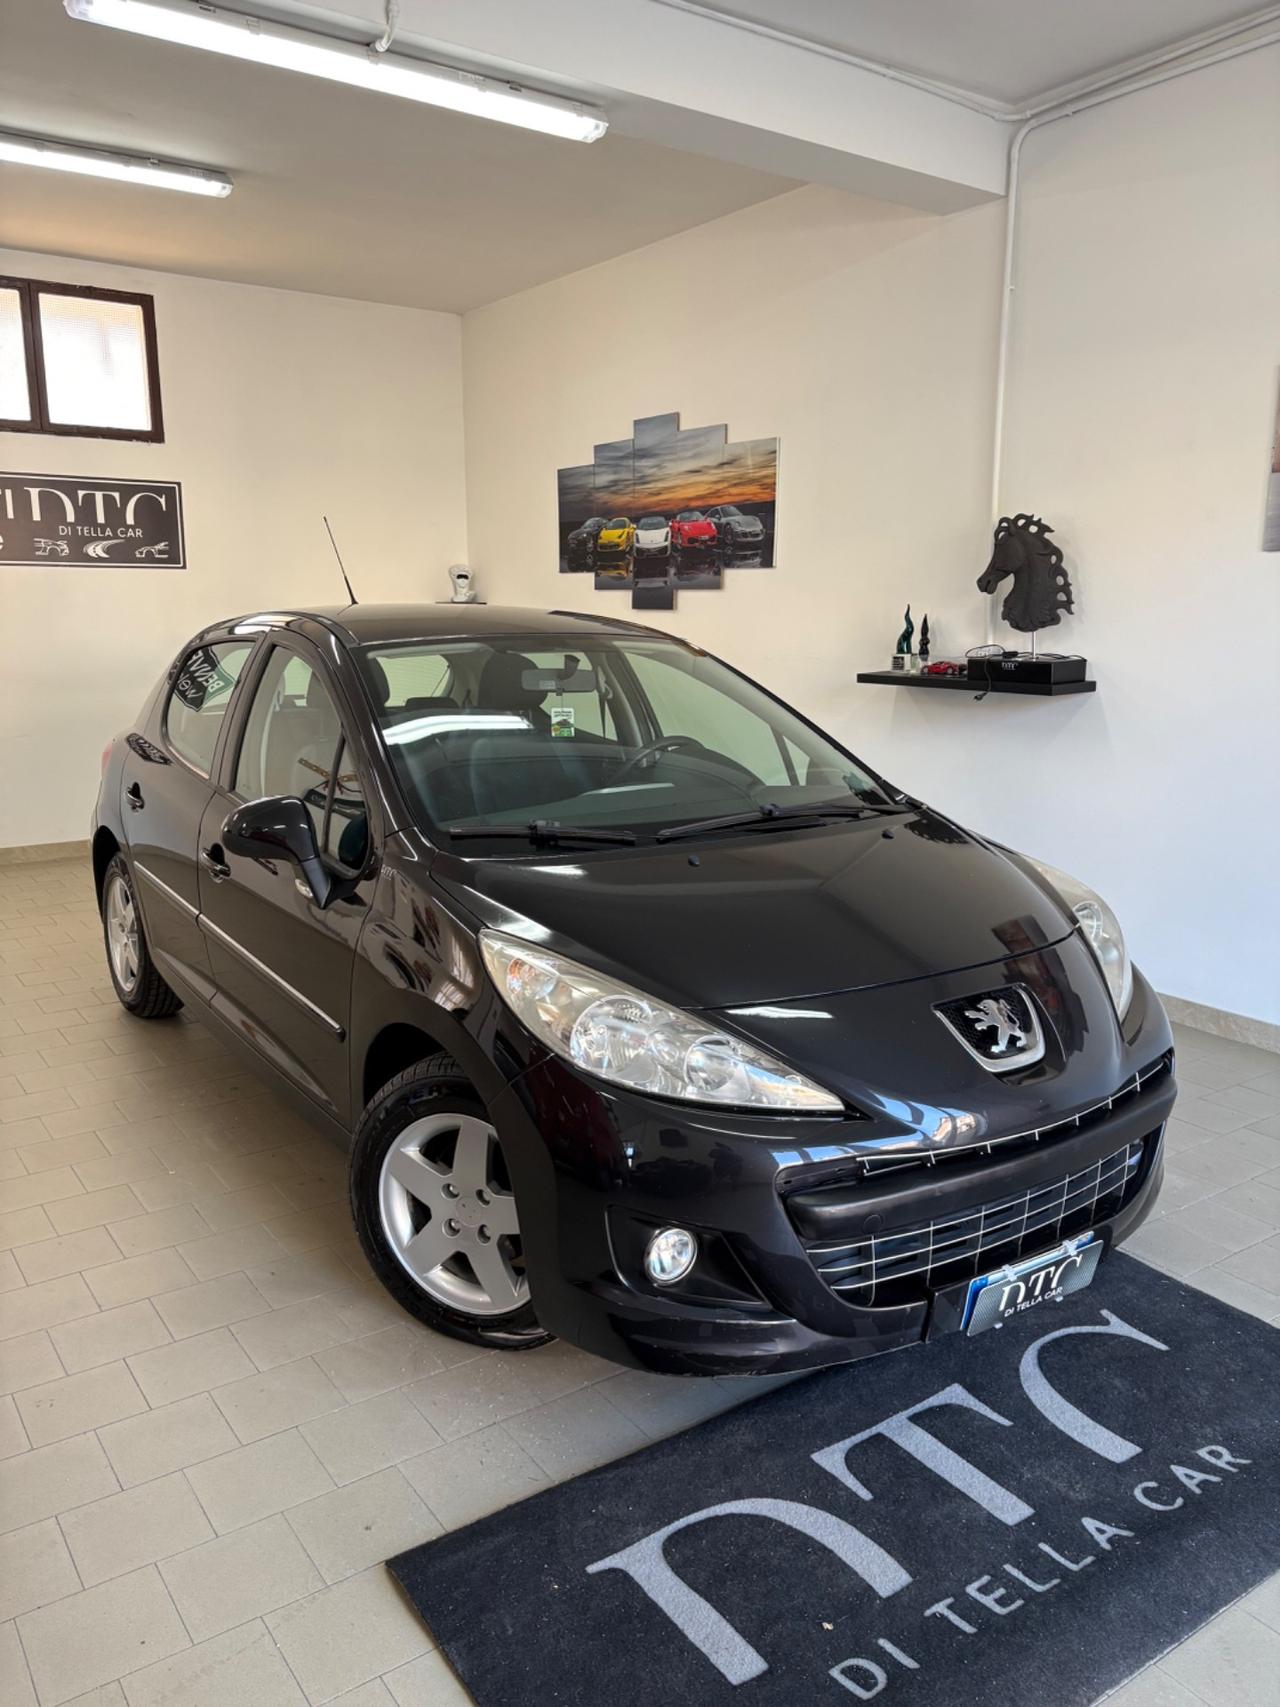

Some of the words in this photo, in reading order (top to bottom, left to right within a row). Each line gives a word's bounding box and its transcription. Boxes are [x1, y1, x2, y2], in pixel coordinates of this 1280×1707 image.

[59, 525, 72, 536] DI
[76, 526, 113, 537] TELLA
[117, 528, 143, 538] CAR
[1004, 1307, 1015, 1317] DI
[1016, 1296, 1043, 1312] TELLA
[1044, 1286, 1063, 1300] CAR
[829, 1638, 920, 1700] DI
[924, 1516, 1134, 1634] TELLA
[1134, 1445, 1251, 1512] CAR
